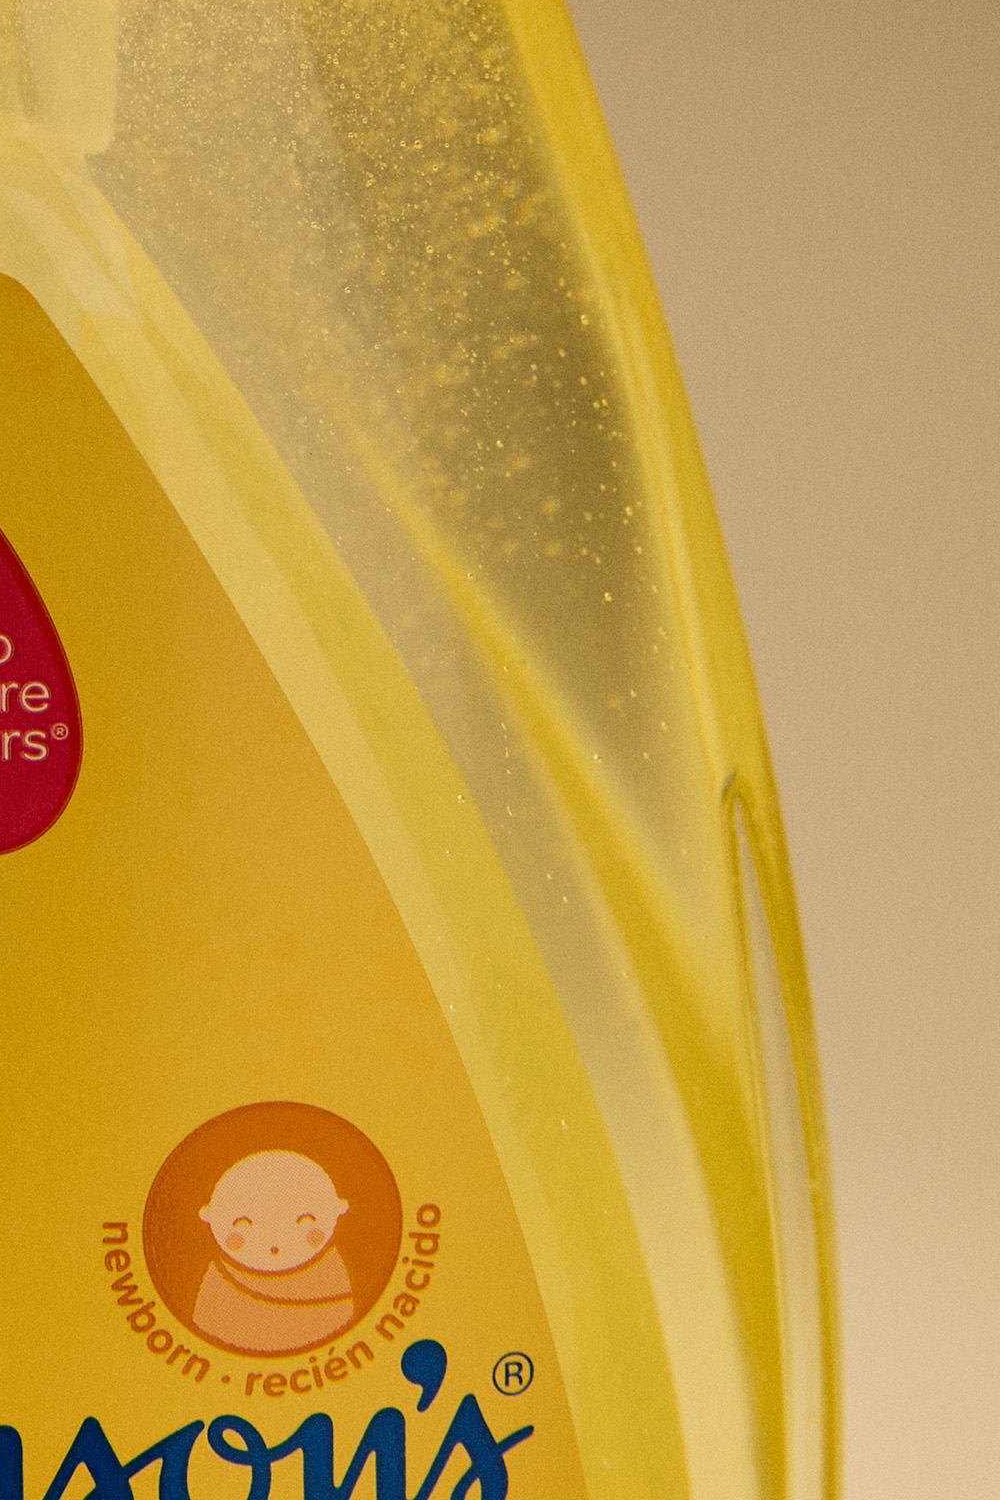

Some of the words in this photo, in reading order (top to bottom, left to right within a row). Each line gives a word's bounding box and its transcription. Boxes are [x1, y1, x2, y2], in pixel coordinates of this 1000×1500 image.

[101, 1220, 211, 1383] newborn
[244, 1339, 375, 1398] recién
[374, 1201, 443, 1340] nacido
